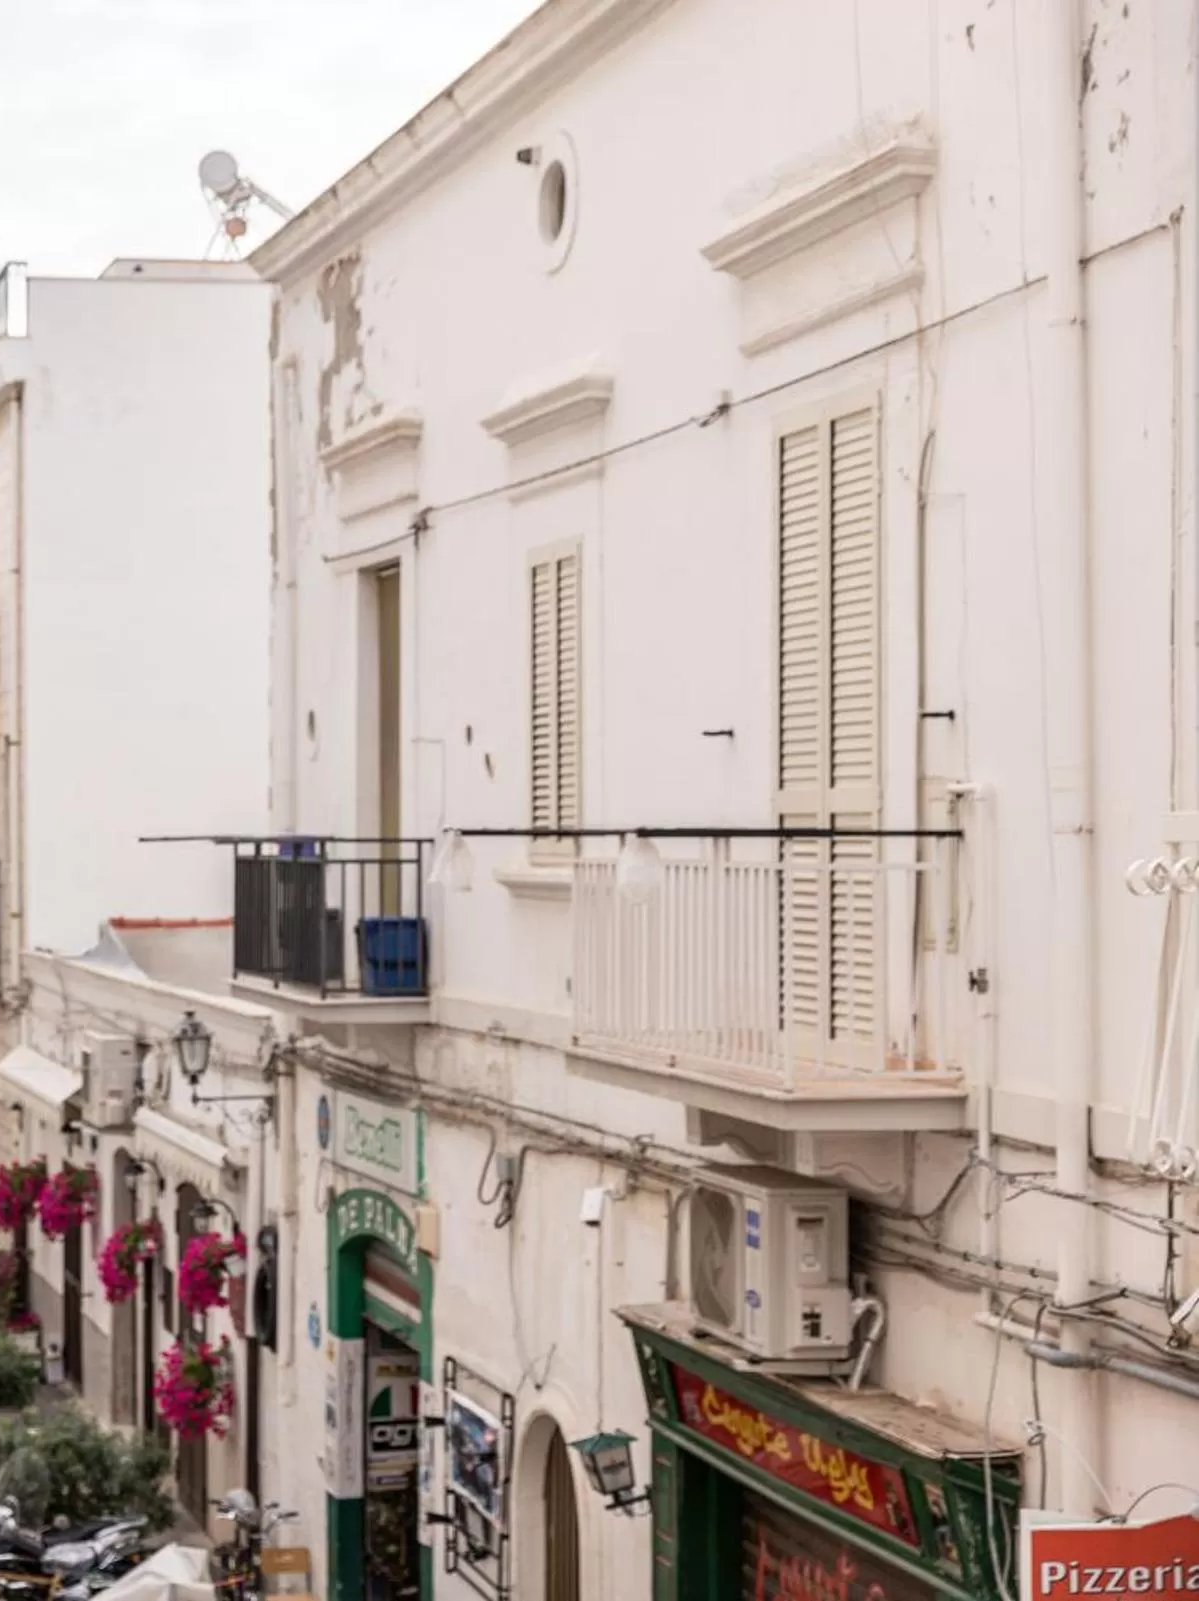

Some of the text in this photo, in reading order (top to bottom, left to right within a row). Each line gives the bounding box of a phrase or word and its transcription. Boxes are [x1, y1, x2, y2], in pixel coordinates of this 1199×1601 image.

[337, 1198, 359, 1238] DE
[702, 1383, 874, 1510] Coyote Ugly
[1039, 1557, 1199, 1595] Pizzeria
